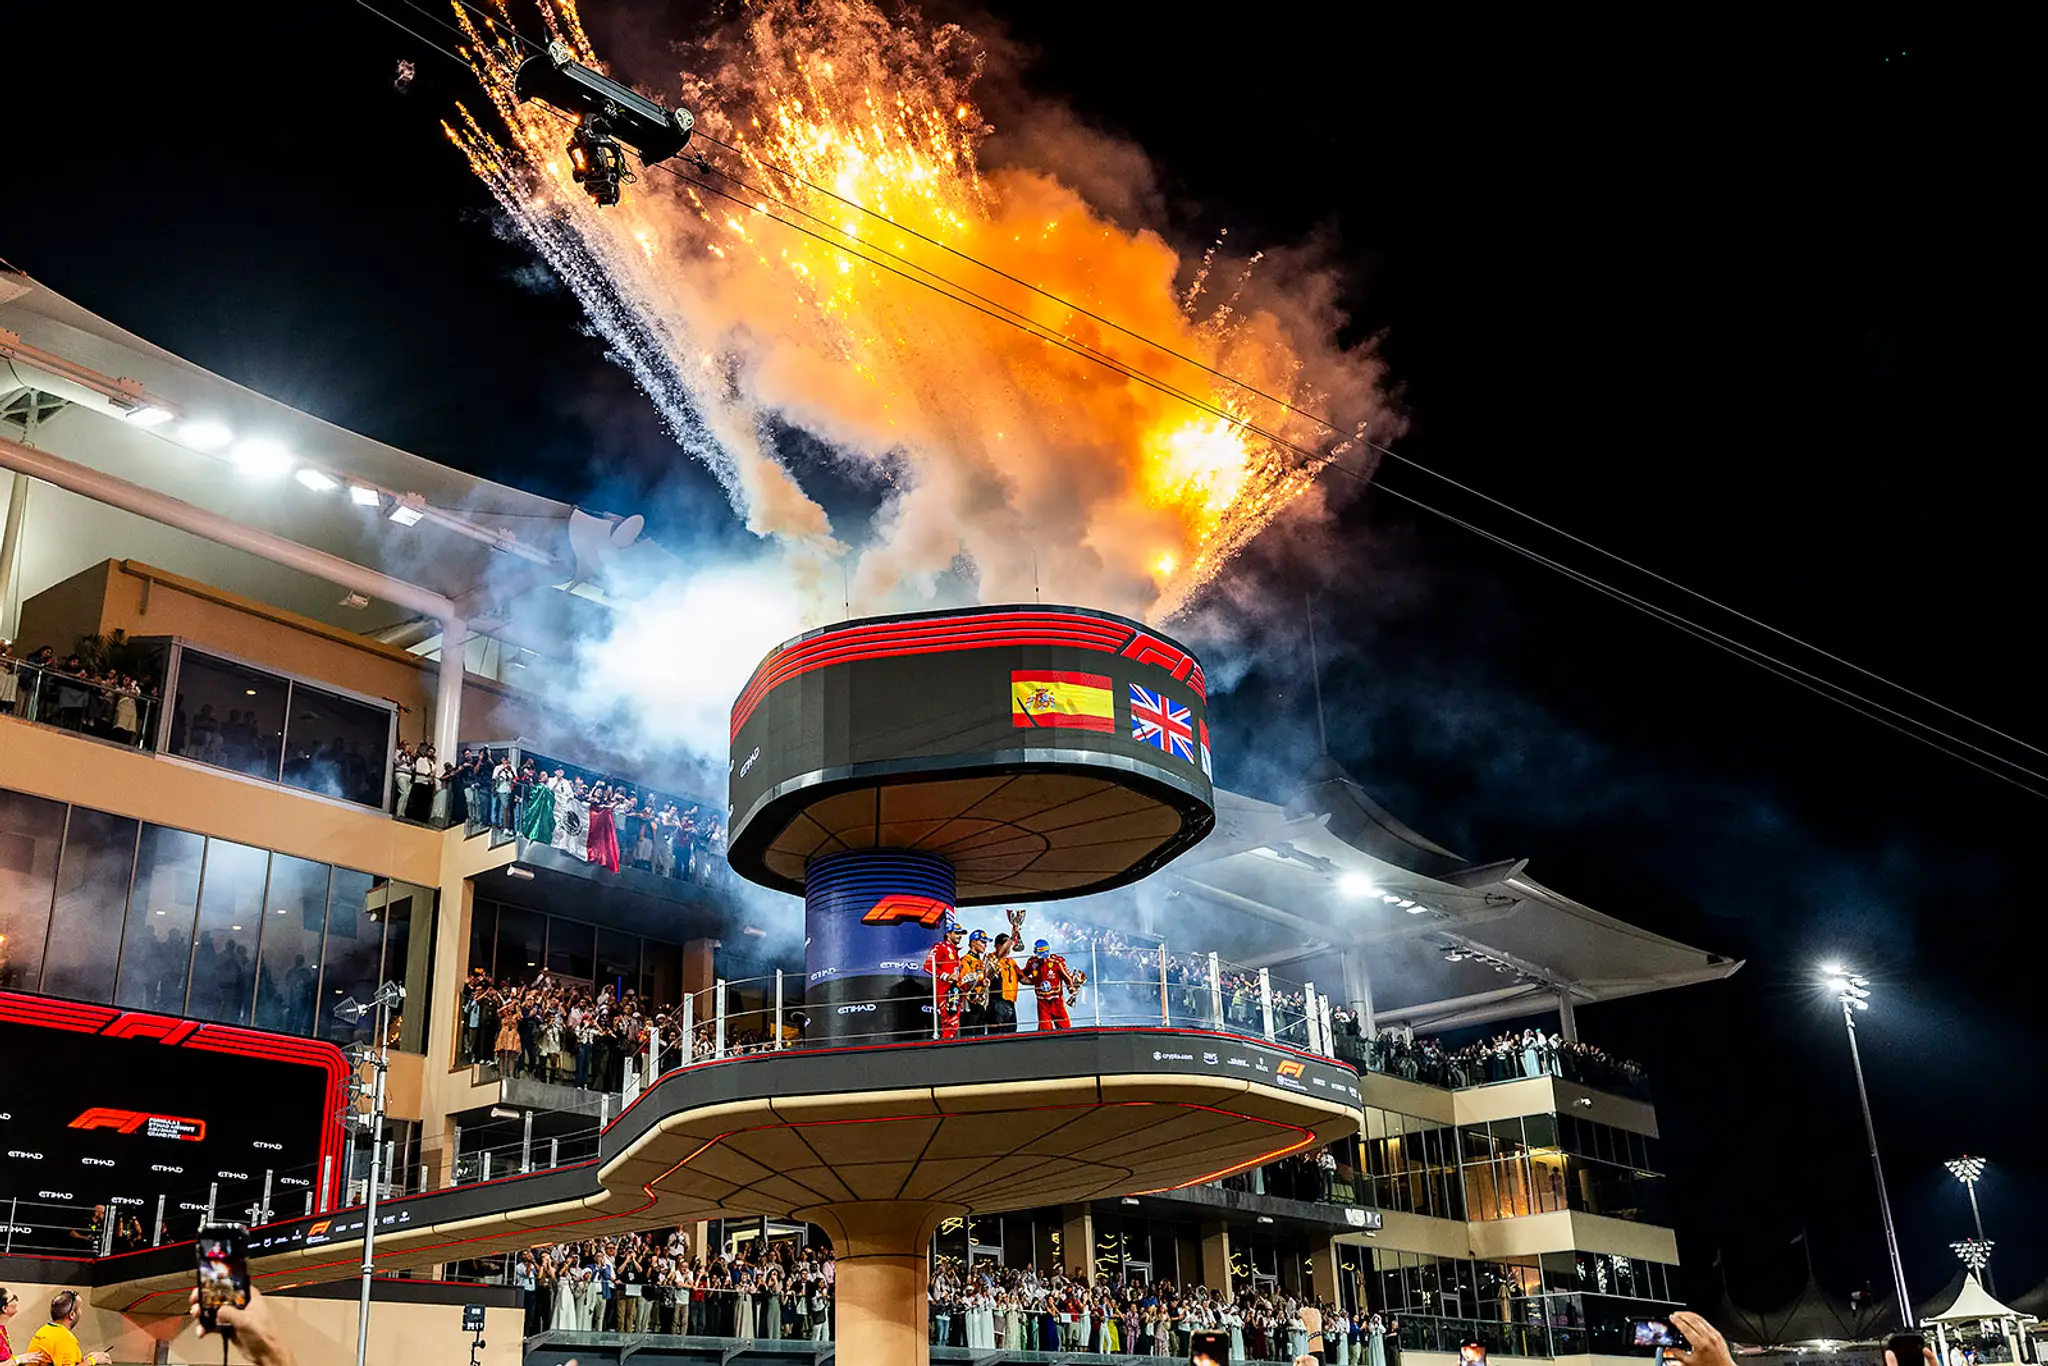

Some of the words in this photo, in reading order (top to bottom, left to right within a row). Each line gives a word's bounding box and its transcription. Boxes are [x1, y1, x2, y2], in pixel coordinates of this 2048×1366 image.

[880, 961, 919, 970] ETIHAD
[837, 1003, 877, 1014] ETIHAD
[253, 1141, 283, 1150] ETIHAD
[8, 1150, 43, 1160] ETIHAD
[82, 1157, 115, 1167] ETIHAD
[151, 1164, 183, 1173] ETIHAD
[218, 1171, 248, 1180] ETIHAD
[281, 1177, 309, 1186] ETIHAD
[39, 1190, 73, 1200] ETIHAD
[111, 1197, 144, 1205] ETIHAD
[0, 1225, 32, 1234] THAD
